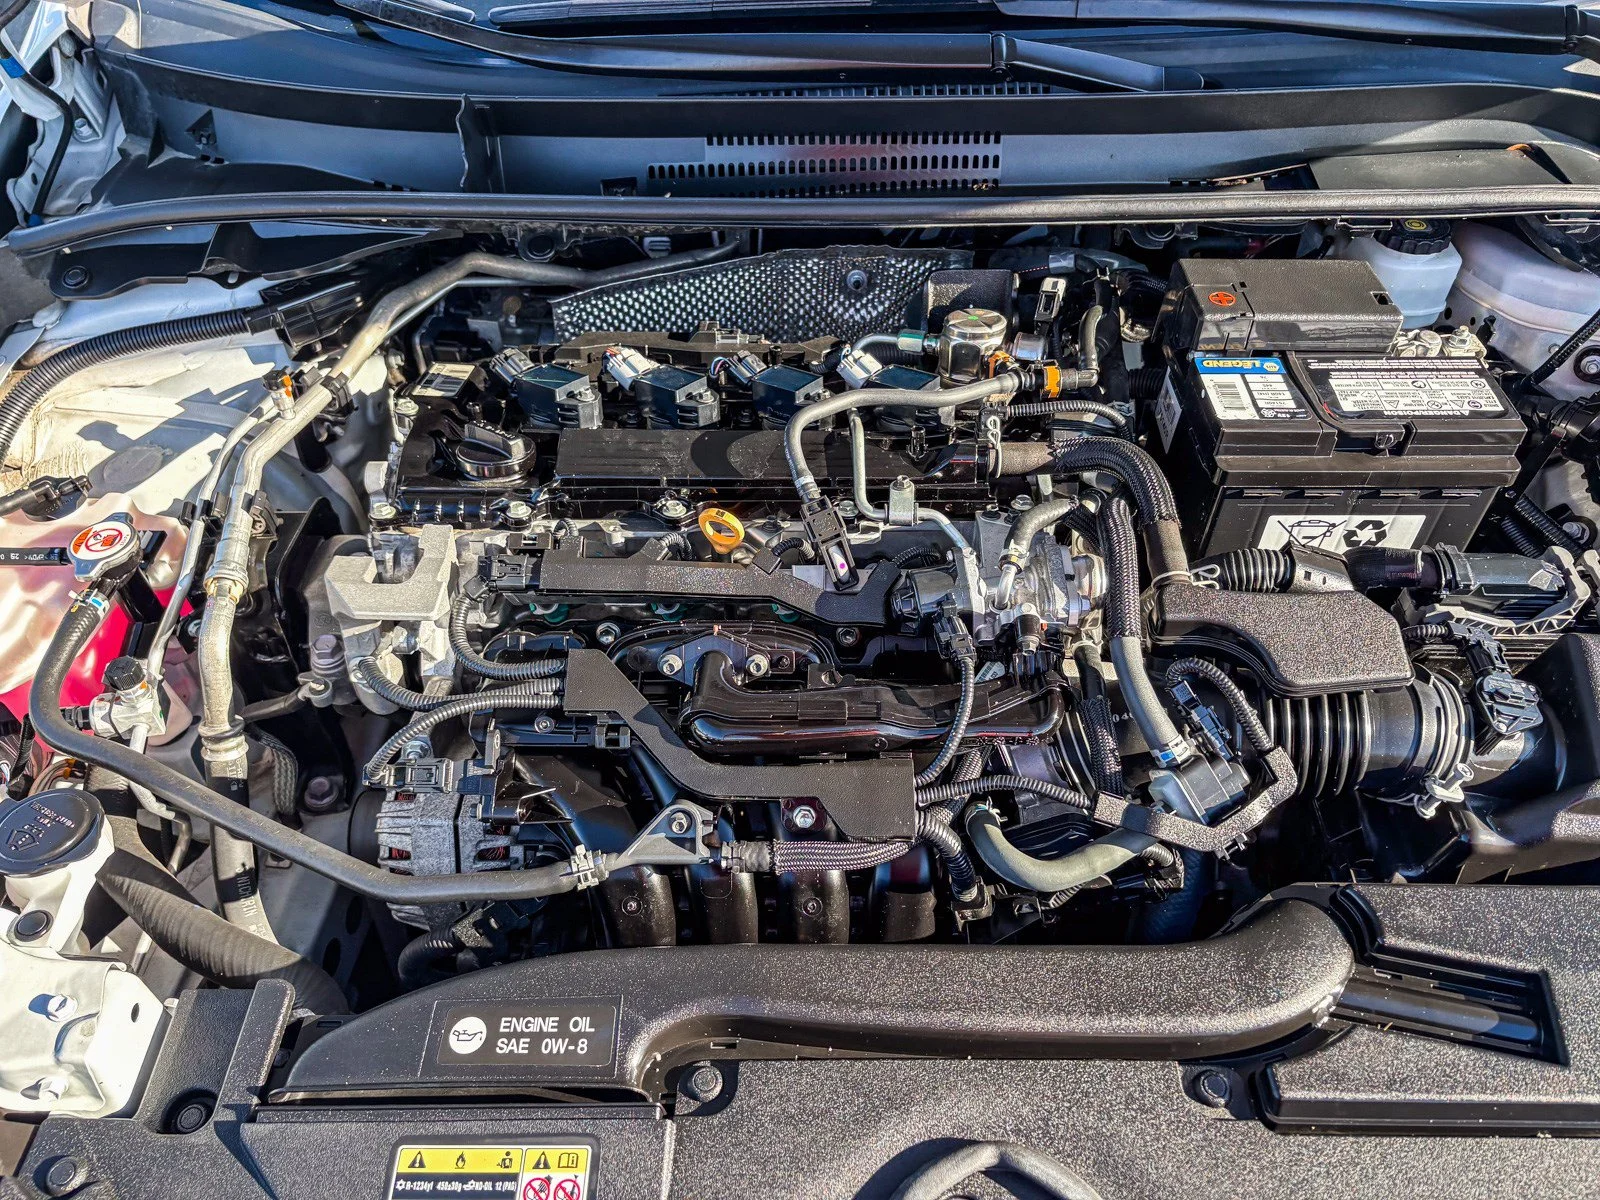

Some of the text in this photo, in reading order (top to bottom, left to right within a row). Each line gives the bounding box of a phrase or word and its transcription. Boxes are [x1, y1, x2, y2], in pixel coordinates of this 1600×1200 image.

[1202, 360, 1261, 368] LEGEND
[499, 1016, 596, 1033] ENGINE OIL
[495, 1038, 588, 1054] SAE 0W-8
